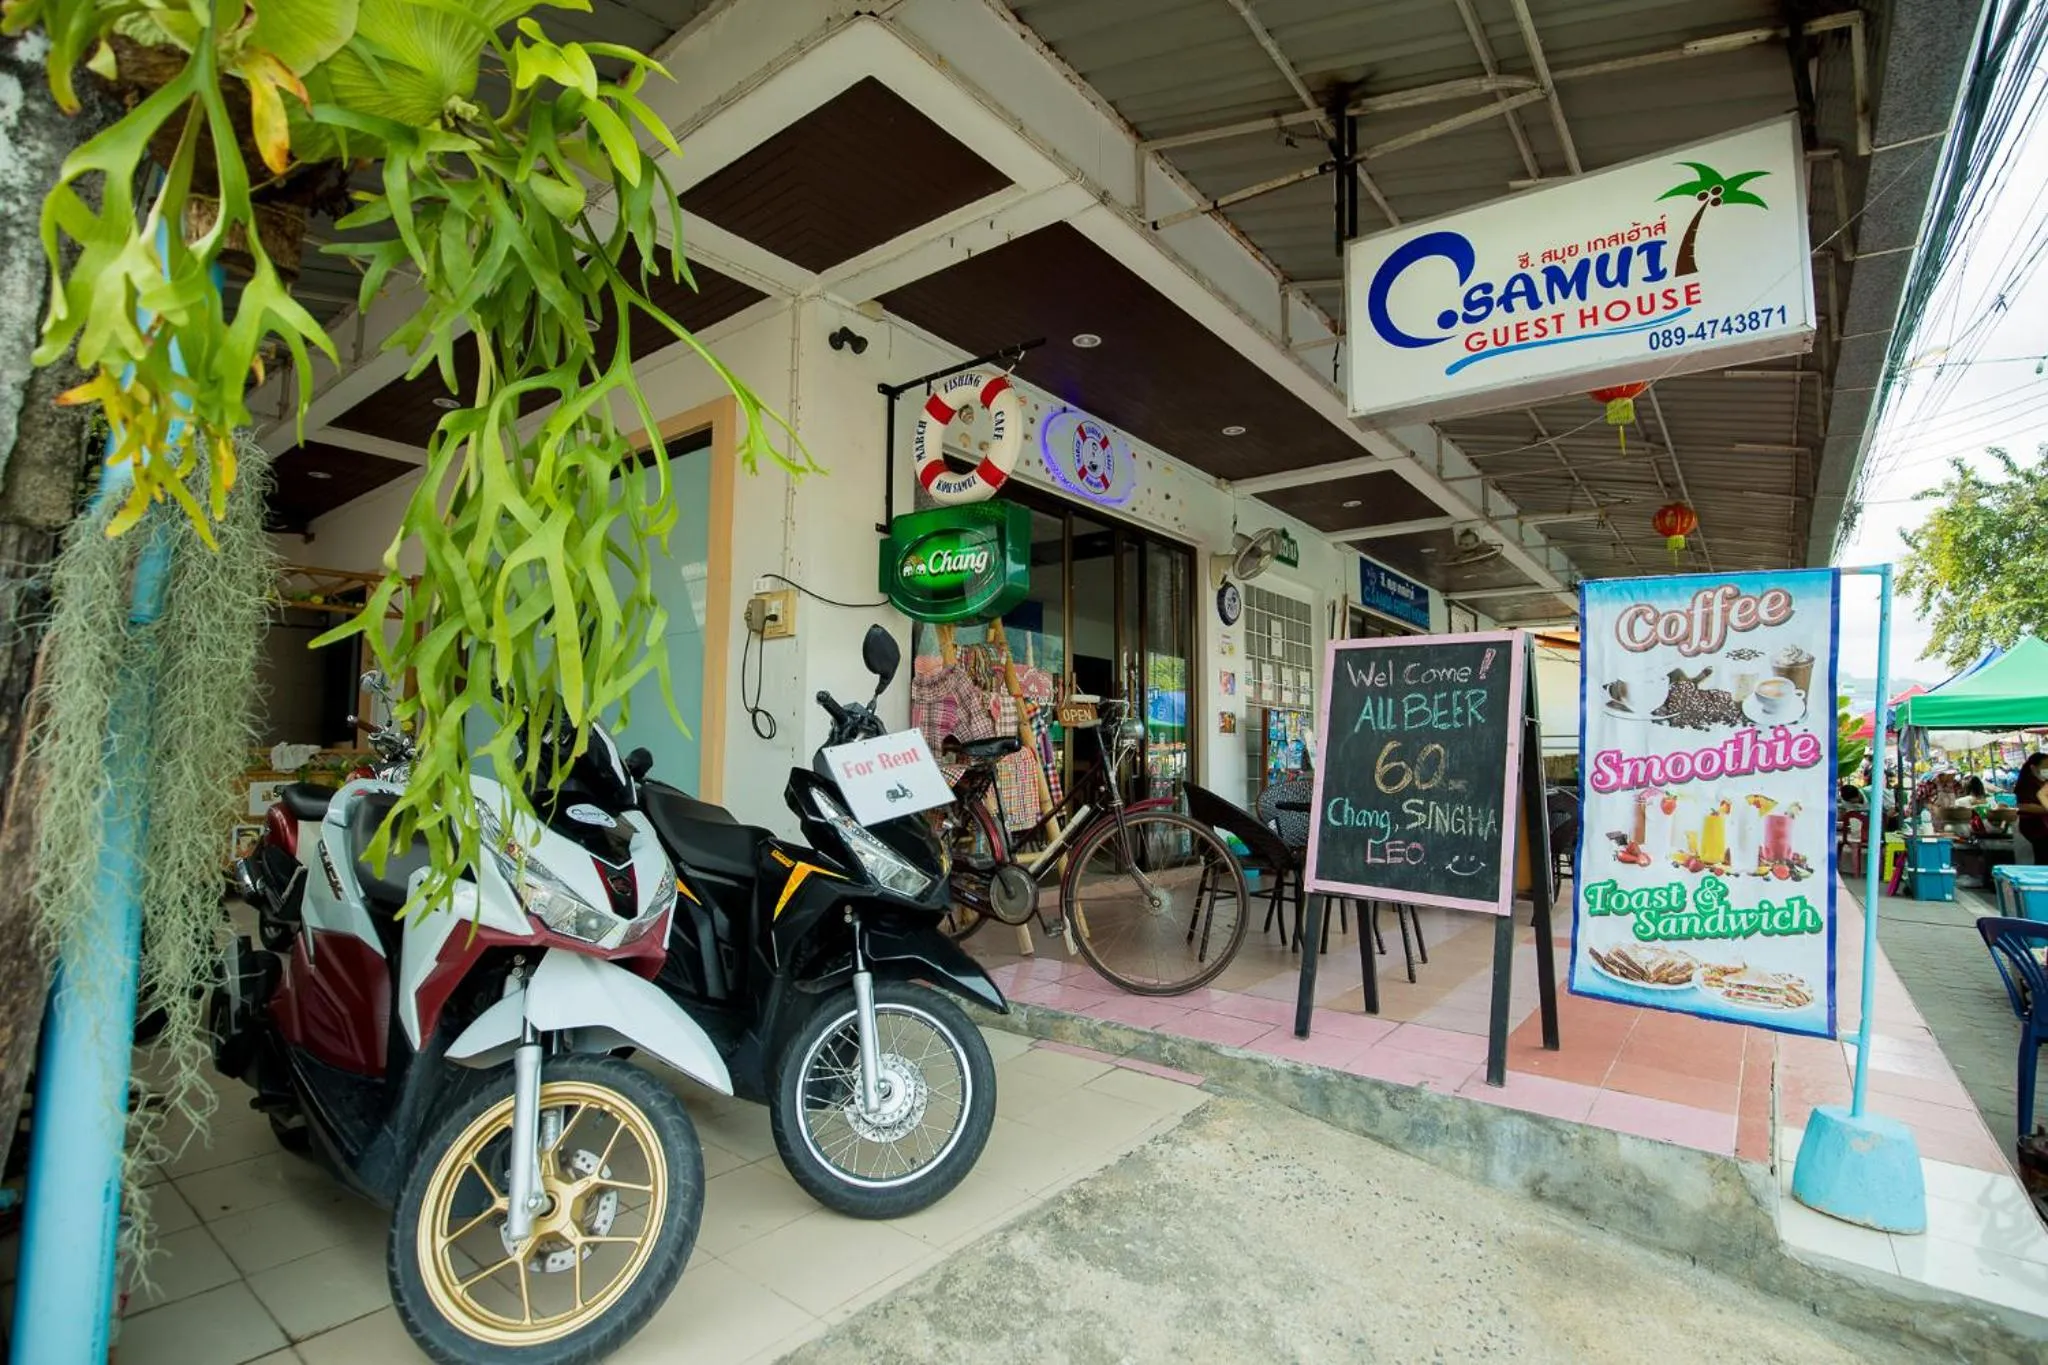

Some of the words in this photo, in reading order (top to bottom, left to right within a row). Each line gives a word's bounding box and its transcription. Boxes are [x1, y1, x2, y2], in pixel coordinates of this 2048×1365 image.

[1541, 244, 1579, 264] สมุย
[1464, 313, 1566, 353] GUEST
[1579, 283, 1702, 328] HOUSE
[1649, 304, 1786, 350] 089-4743871
[914, 420, 928, 462] MARCH
[944, 374, 982, 394] FISHING
[992, 410, 1005, 440] CAFE
[928, 549, 988, 575] Chang
[1615, 584, 1793, 657] Coffee
[1346, 659, 1394, 688] Wel
[1063, 708, 1092, 722] OPEN
[1401, 687, 1488, 731] BEER
[842, 760, 874, 779] For
[878, 747, 920, 770] Rent
[1590, 726, 1821, 793] Smoothie
[1402, 799, 1498, 841] SINGHA
[1584, 879, 1687, 916] Toast
[1693, 875, 1729, 913] &
[1633, 896, 1823, 941] Sandwich
